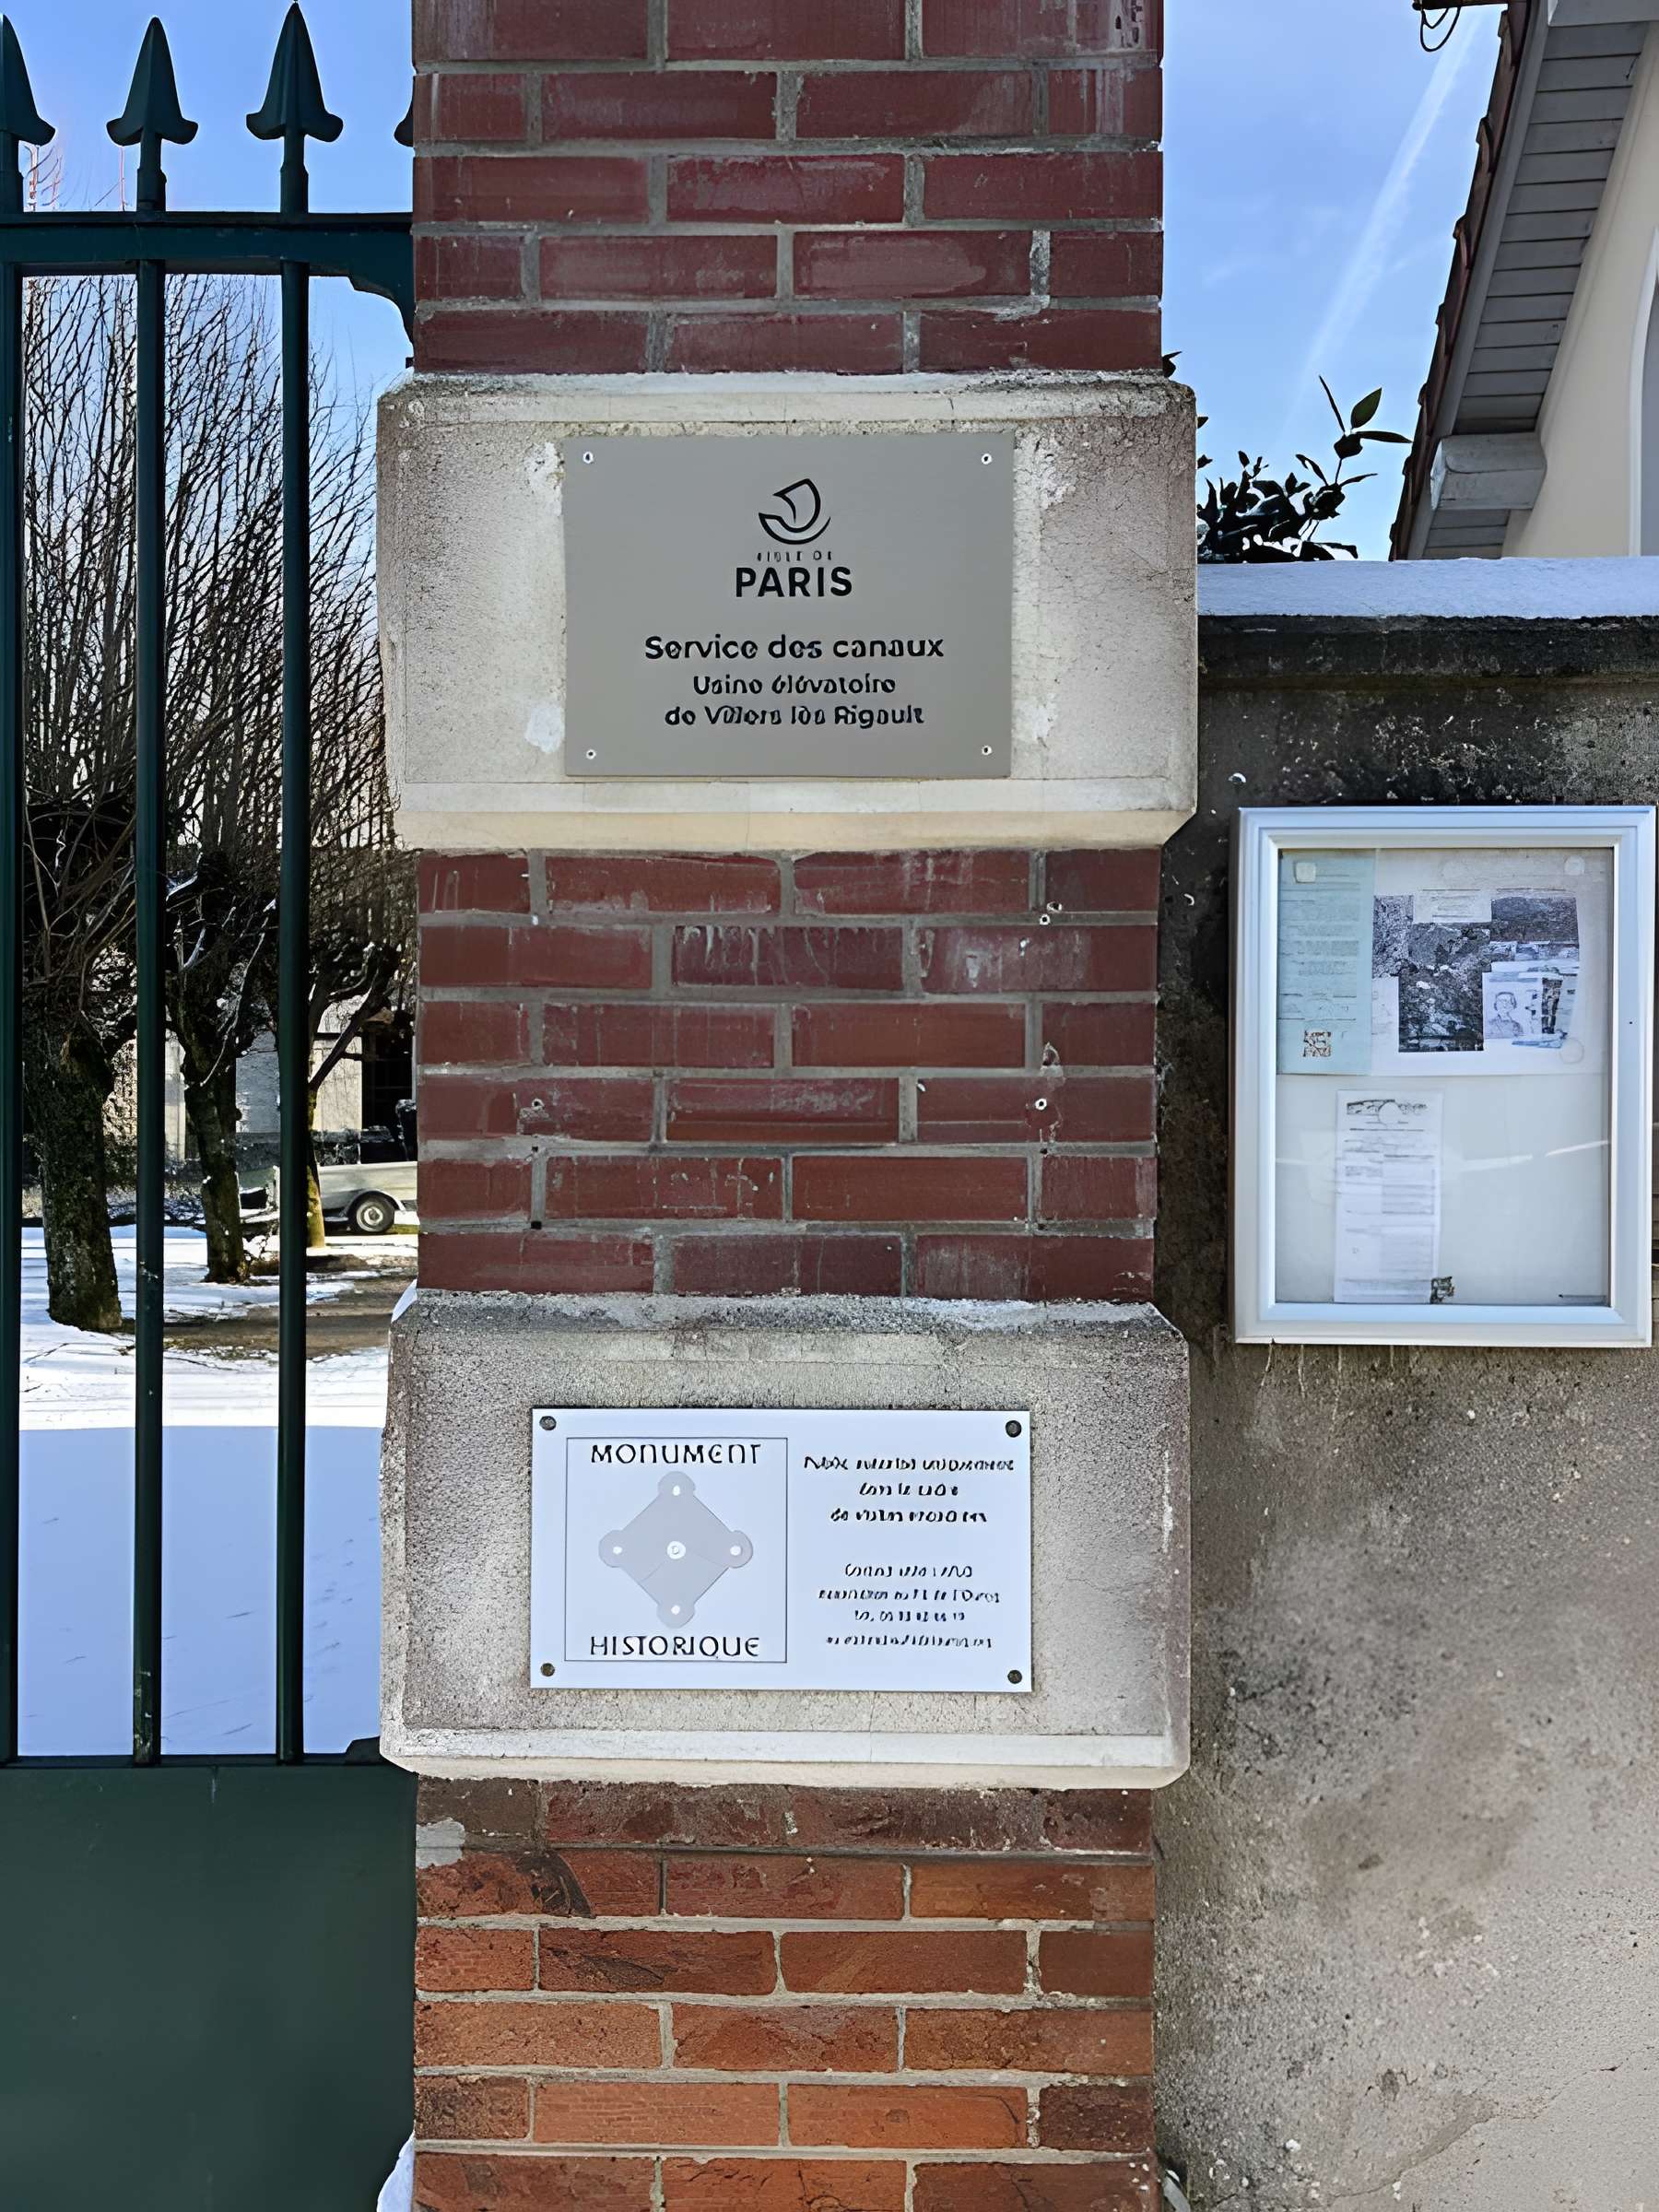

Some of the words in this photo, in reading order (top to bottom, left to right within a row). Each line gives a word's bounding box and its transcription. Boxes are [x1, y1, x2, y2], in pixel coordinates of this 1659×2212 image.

[735, 566, 853, 597] PARIS
[644, 633, 759, 660] Service
[767, 633, 823, 659] des
[832, 638, 945, 659] canaux
[591, 1443, 761, 1465] MONUMENT
[590, 1635, 760, 1660] HISTORIQUE
